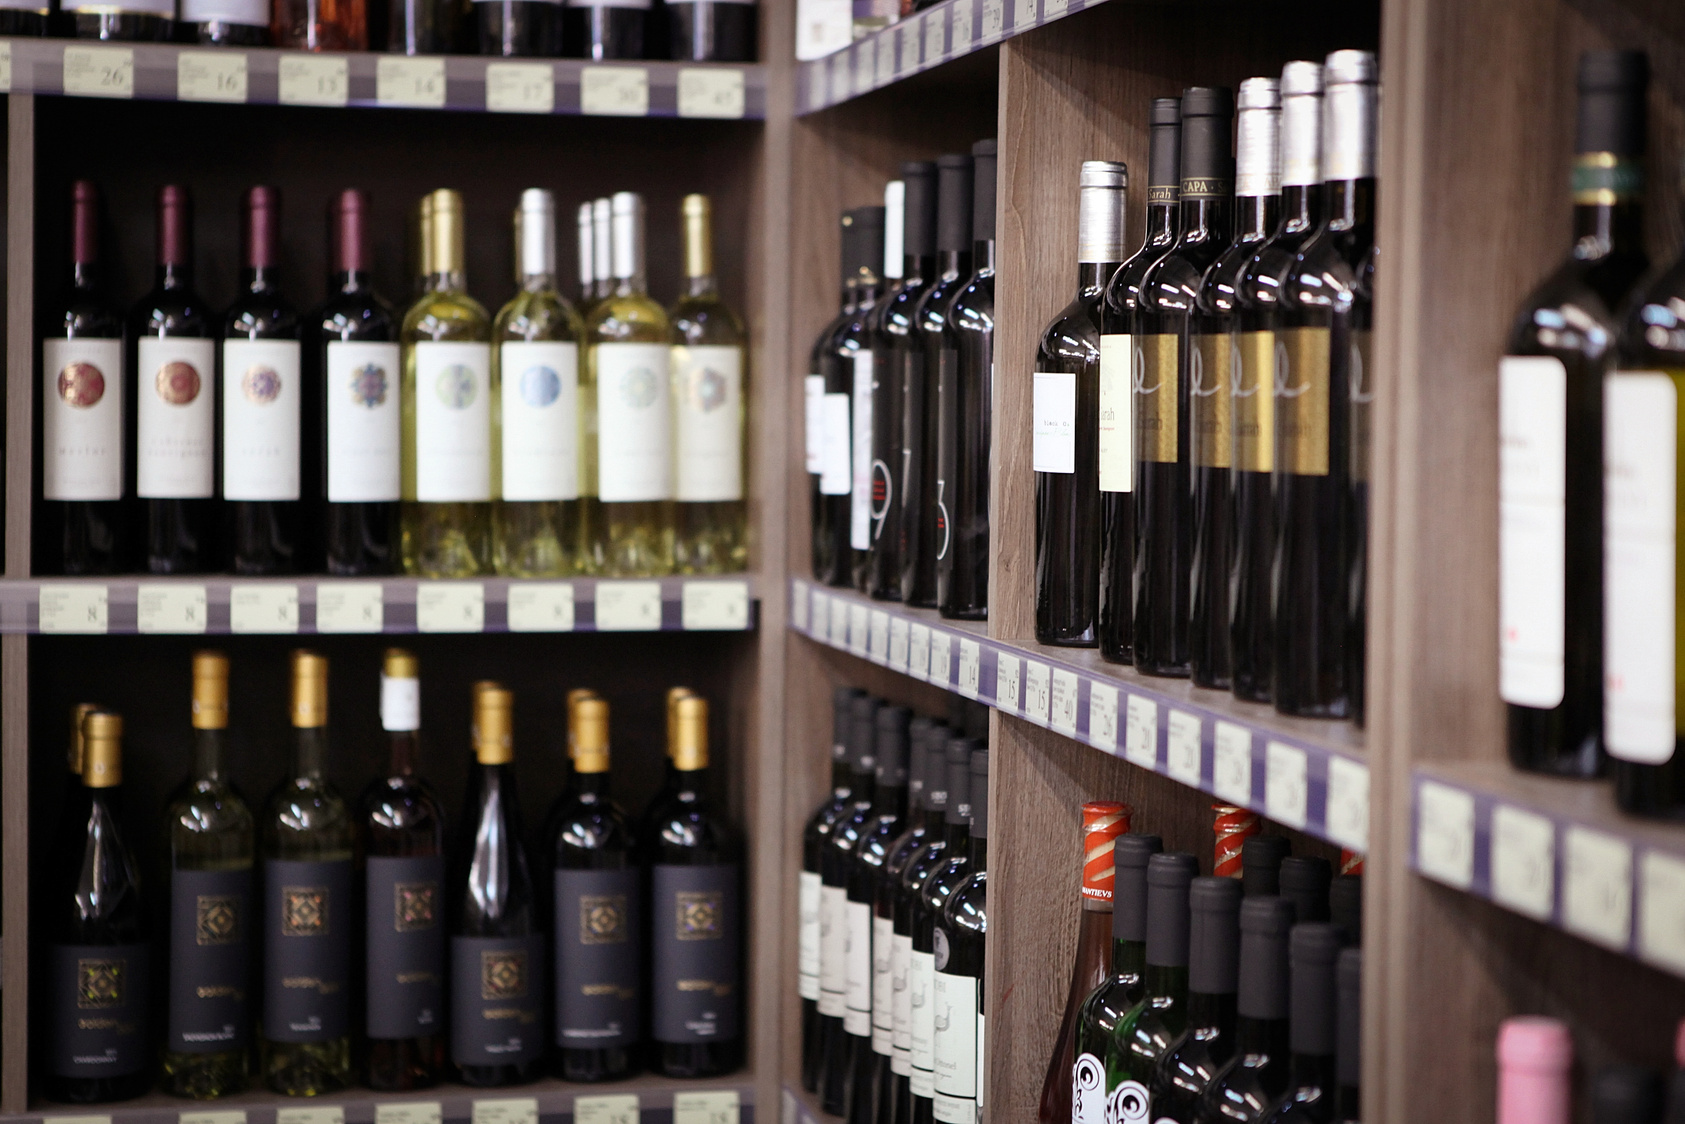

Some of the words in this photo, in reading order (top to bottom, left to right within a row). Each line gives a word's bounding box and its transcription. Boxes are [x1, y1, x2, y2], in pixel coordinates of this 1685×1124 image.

[101, 68, 124, 87] 26
[217, 71, 239, 91] 16
[1148, 187, 1171, 200] Sarah
[1183, 180, 1209, 193] CAPA
[968, 665, 977, 685] 14
[1008, 679, 1016, 700] 15
[1038, 689, 1046, 711] 15
[1064, 699, 1074, 722] 40
